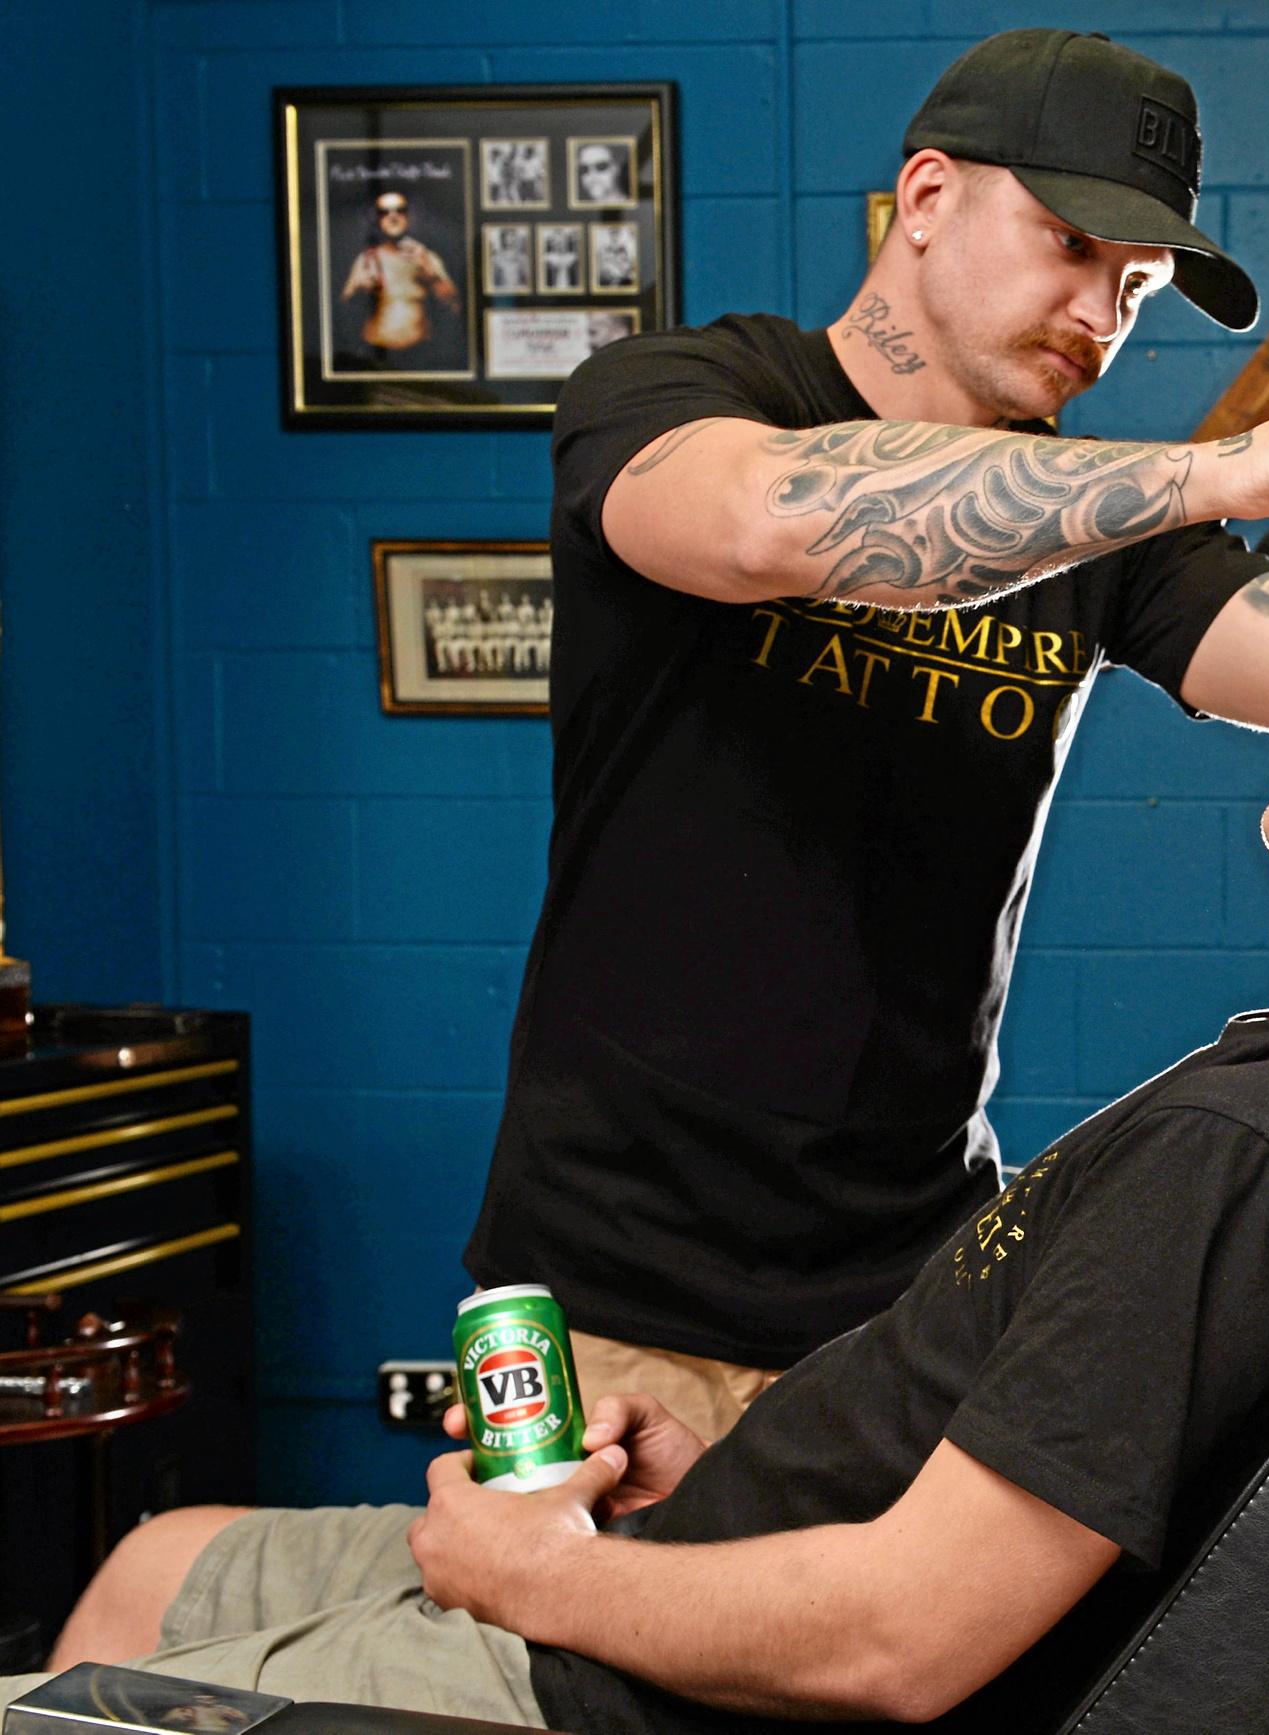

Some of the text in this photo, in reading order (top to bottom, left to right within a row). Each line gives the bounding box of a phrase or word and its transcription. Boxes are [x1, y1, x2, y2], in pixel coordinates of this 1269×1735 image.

[751, 607, 1074, 742] TATTO
[464, 1327, 551, 1371] VICTORIA
[480, 1366, 543, 1406] VB
[482, 1413, 562, 1448] BITTER
